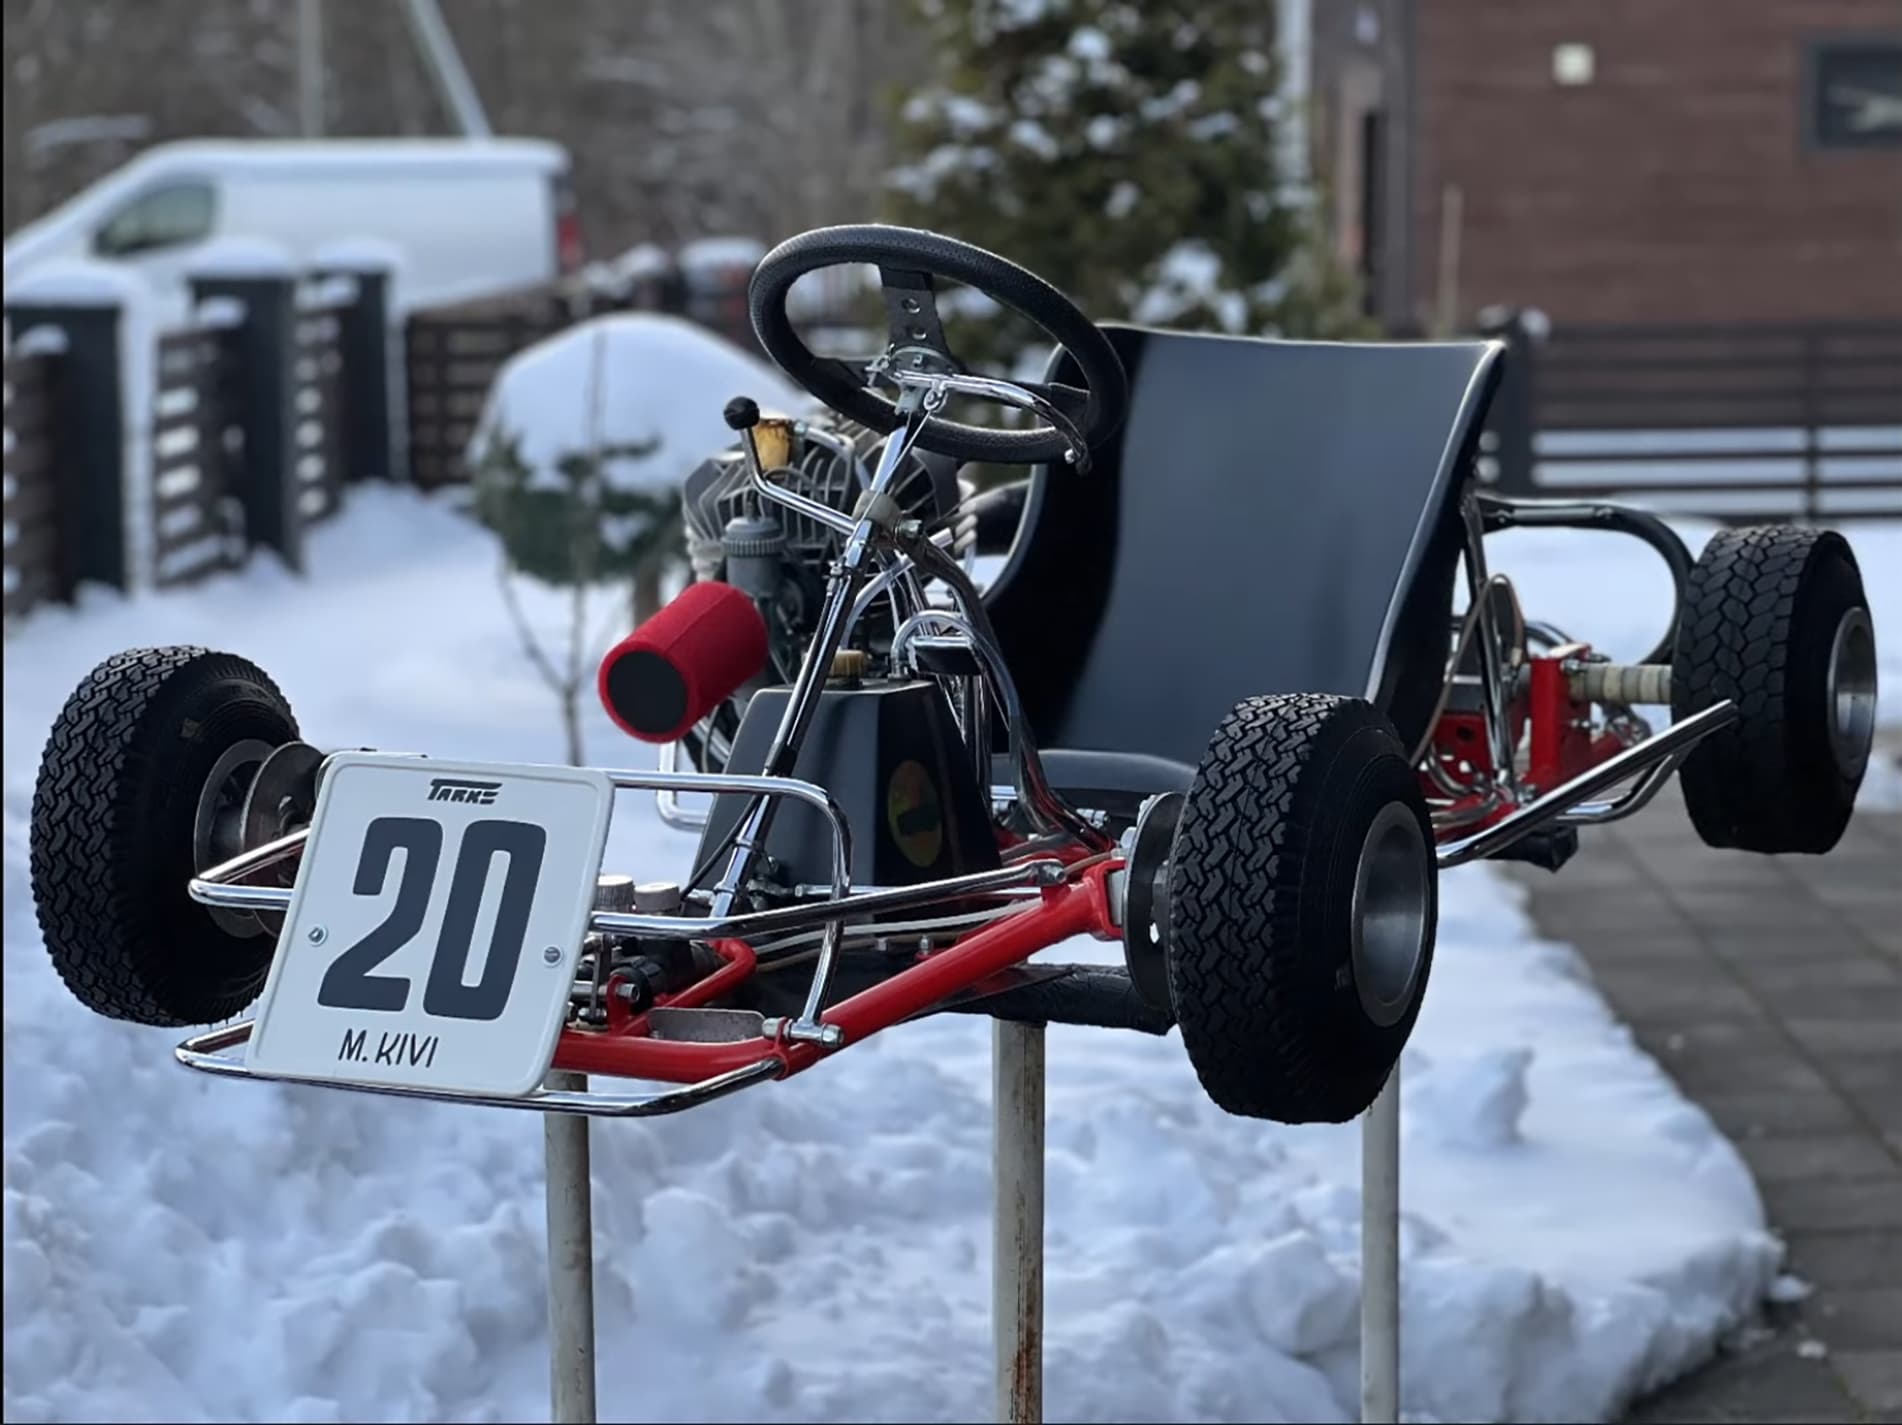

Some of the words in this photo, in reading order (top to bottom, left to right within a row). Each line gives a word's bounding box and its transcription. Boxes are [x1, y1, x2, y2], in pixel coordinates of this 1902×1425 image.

[317, 816, 547, 1021] 20
[338, 1028, 368, 1062] M.
[375, 1031, 439, 1068] KIVI
